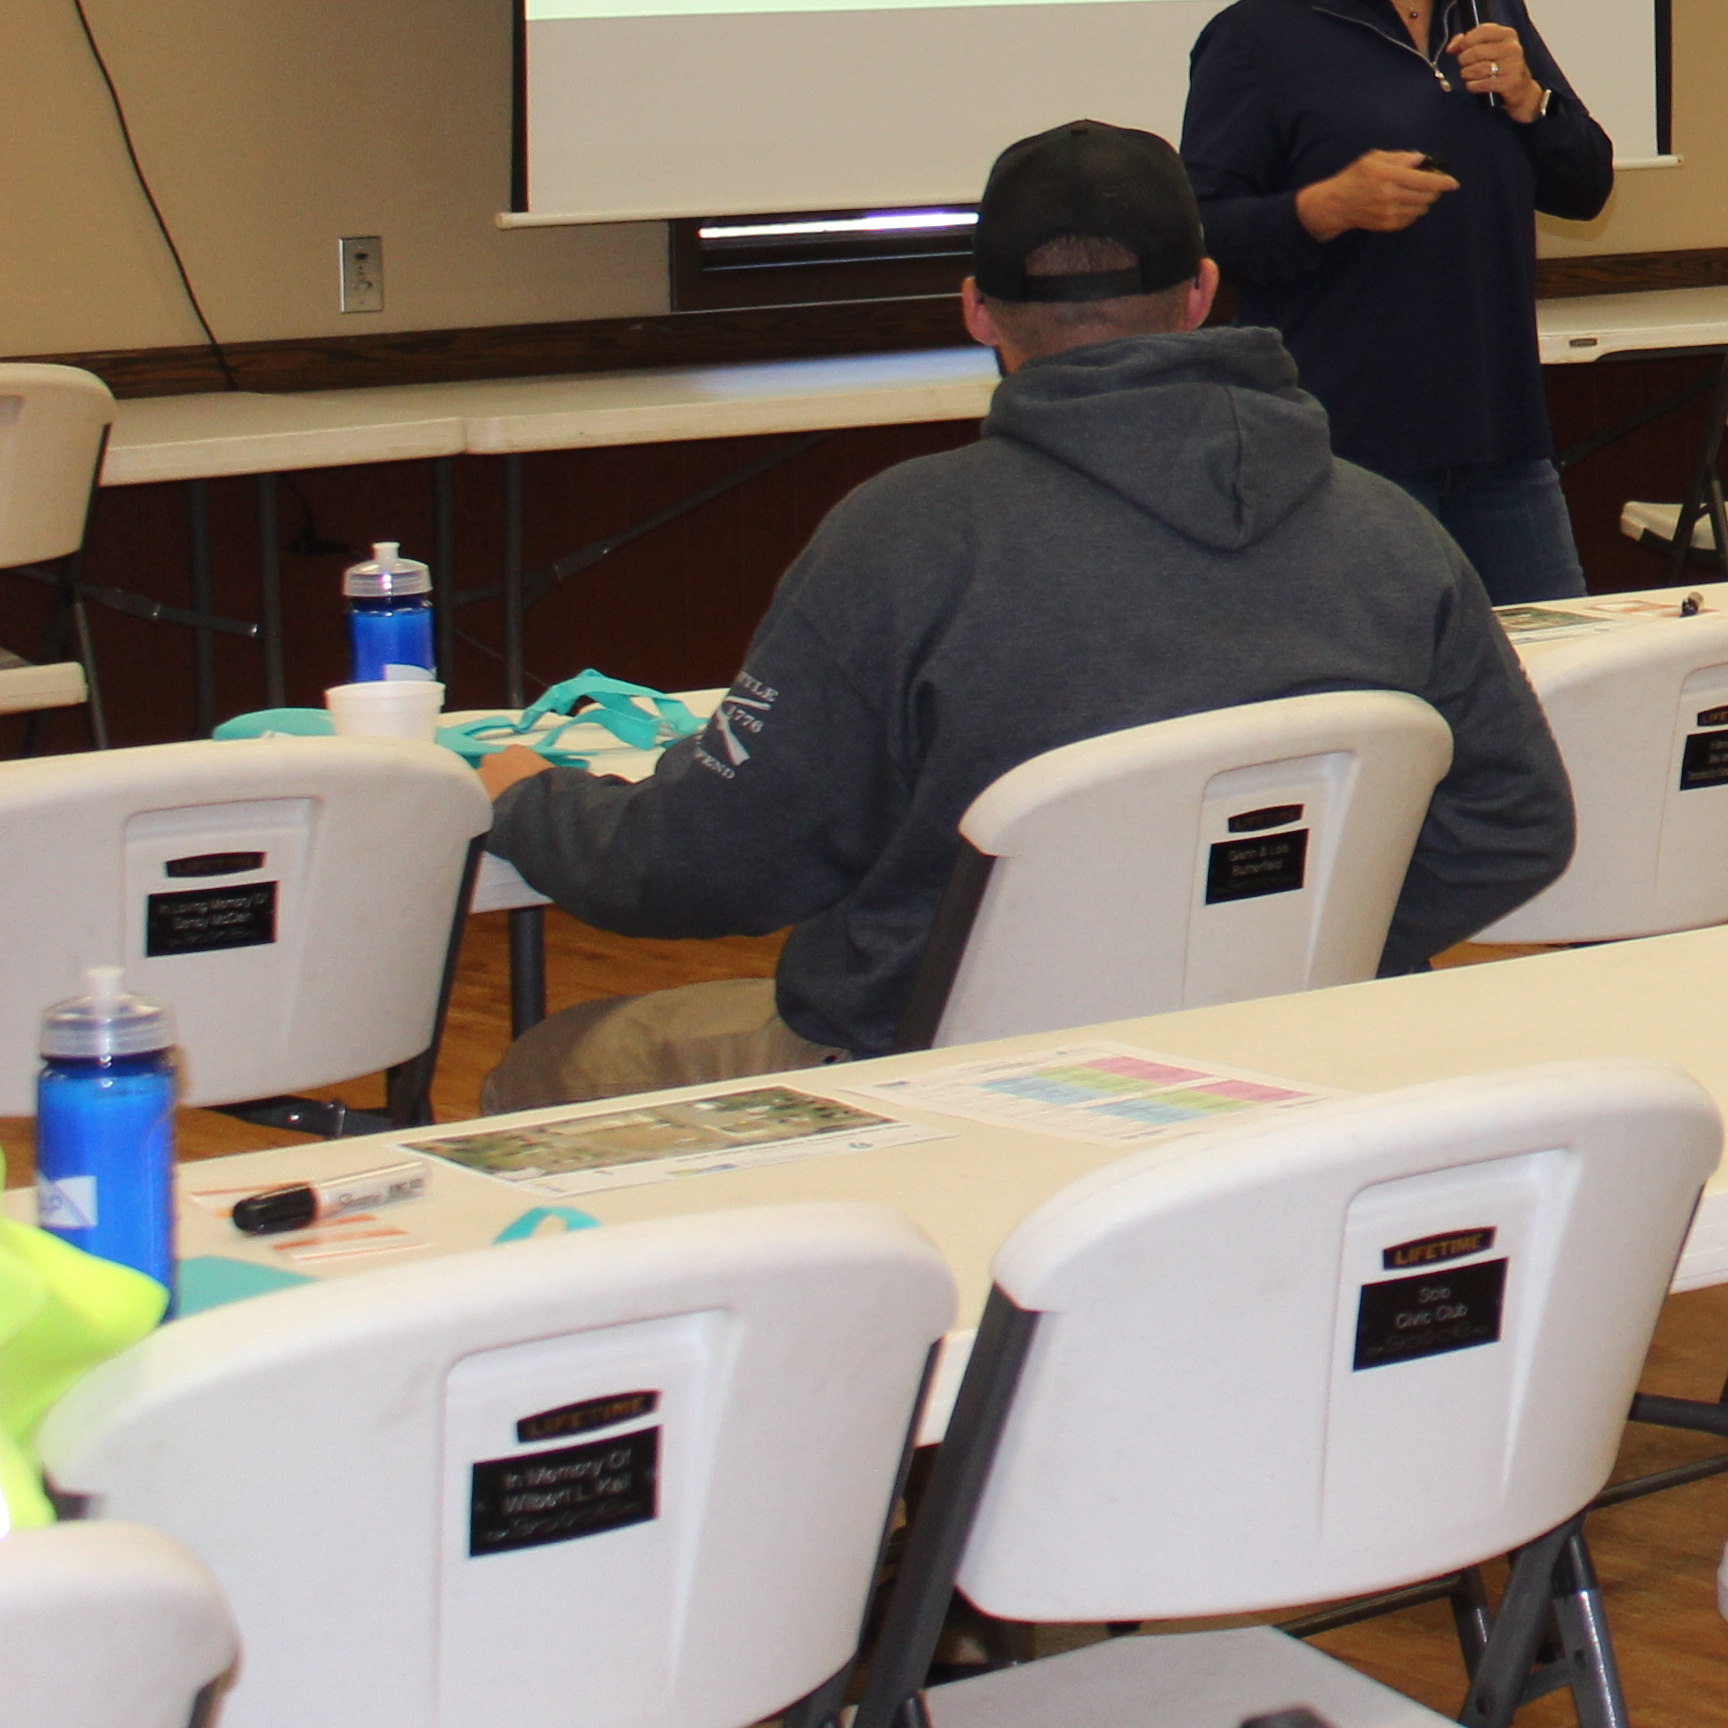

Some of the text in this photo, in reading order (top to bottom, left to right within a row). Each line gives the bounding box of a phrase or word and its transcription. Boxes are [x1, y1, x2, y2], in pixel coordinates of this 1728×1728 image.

[724, 704, 764, 733] 1776
[1394, 1233, 1482, 1266] LIFETIME
[1396, 1304, 1468, 1329] Civic Club
[527, 1396, 646, 1437] LIFETIME
[527, 1457, 603, 1485] Memory
